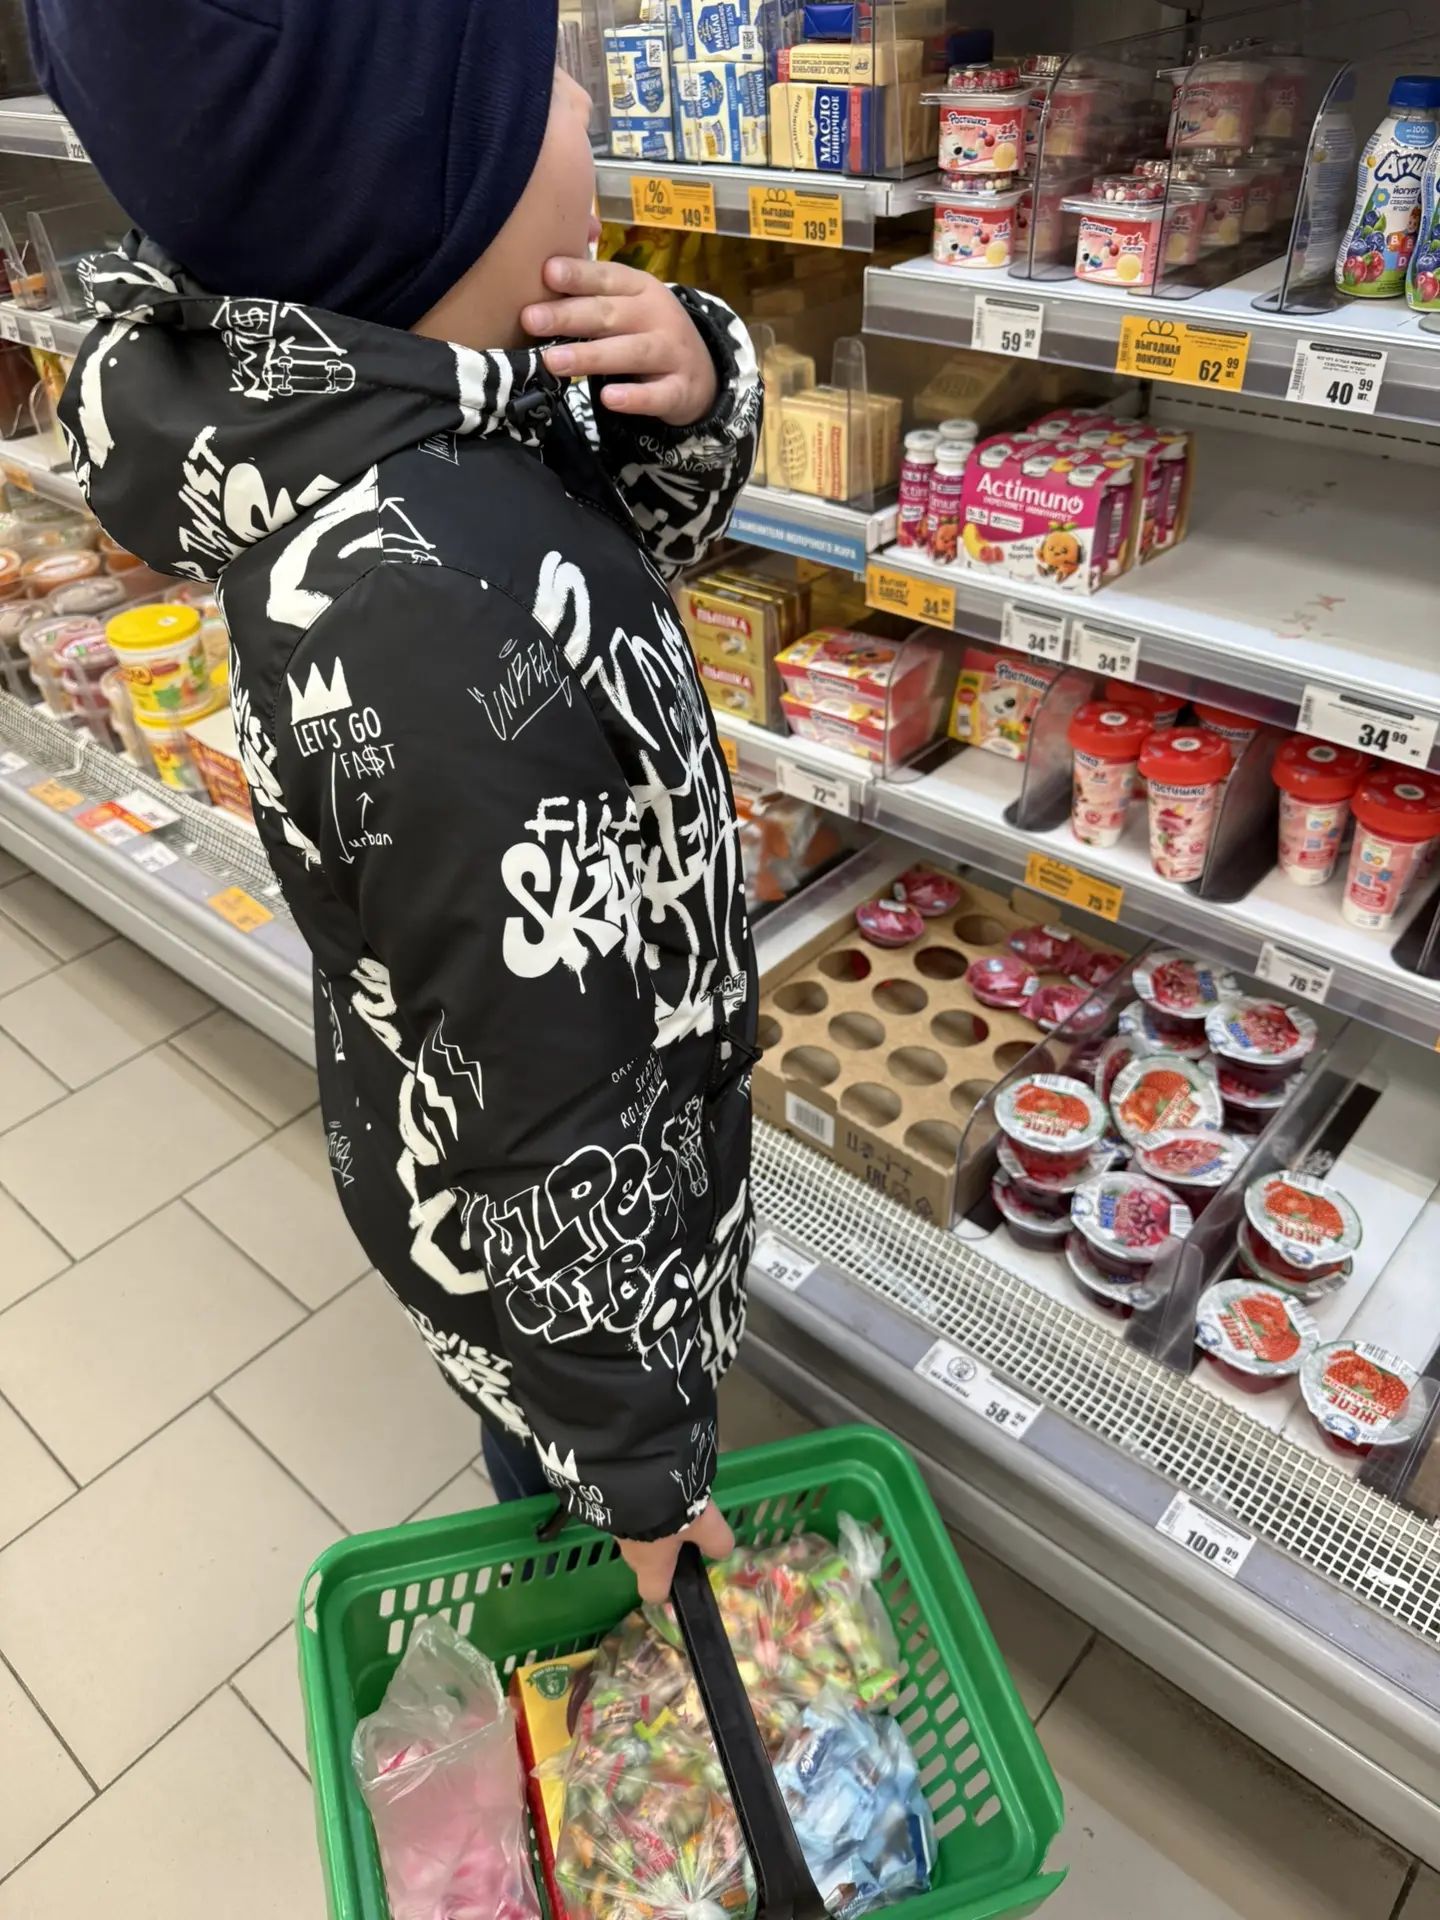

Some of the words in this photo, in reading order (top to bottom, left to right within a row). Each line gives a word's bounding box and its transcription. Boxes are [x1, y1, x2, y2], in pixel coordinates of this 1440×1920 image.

[819, 95, 831, 163] МАСЛО
[831, 96, 840, 164] СЛИВОЧНОЕ
[1393, 185, 1420, 195] ЙОГУРТ
[682, 207, 700, 227] 149
[803, 220, 827, 241] 139
[1001, 331, 1021, 352] 59
[1025, 329, 1036, 340] 99
[1135, 340, 1181, 355] ВЫГОДНАЯ
[1136, 353, 1176, 368] ПОКУПКА!
[1199, 360, 1222, 382] 62
[1227, 358, 1239, 369] 99
[1326, 381, 1353, 405] 40
[1359, 379, 1374, 392] 99
[977, 473, 1083, 514] Actimuno
[1028, 633, 1045, 652] 34
[1098, 653, 1116, 673] 34
[293, 717, 341, 757] LET'S
[349, 707, 382, 744] GO
[1358, 724, 1390, 752] 34
[1392, 731, 1407, 745] 99
[340, 743, 396, 780] FA$T
[349, 830, 393, 848] urban
[1288, 974, 1307, 992] 76
[985, 1400, 1010, 1423] 58
[1328, 1393, 1377, 1425] ЖЕЛЕ
[578, 1485, 604, 1504] GO
[1186, 1530, 1220, 1561] 100
[1225, 1547, 1239, 1560] 99
